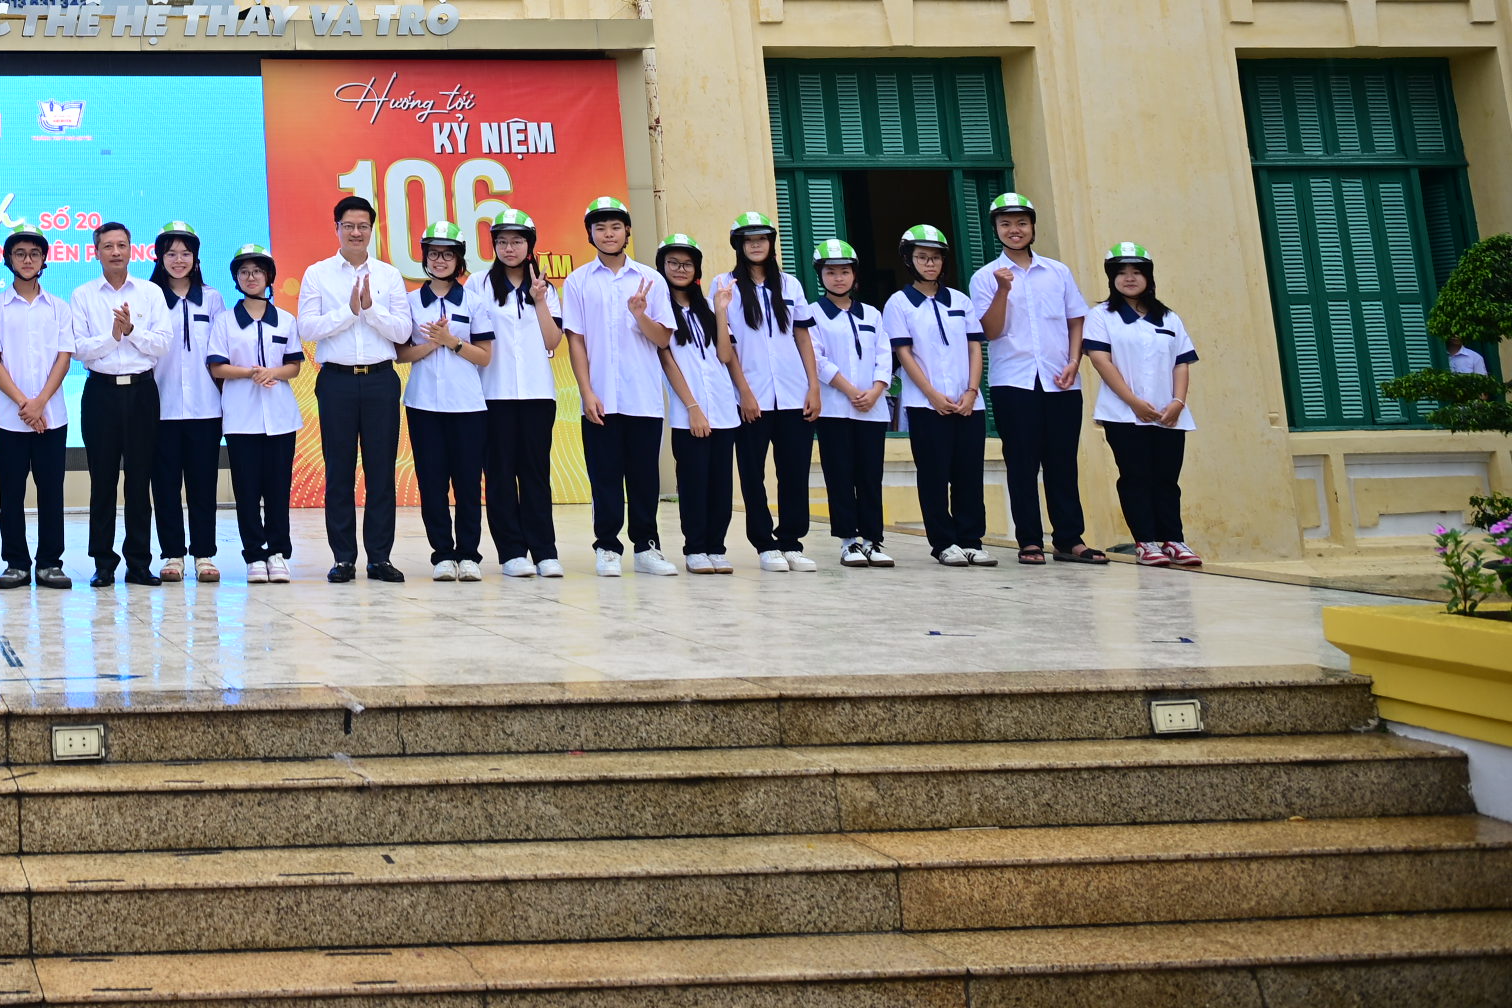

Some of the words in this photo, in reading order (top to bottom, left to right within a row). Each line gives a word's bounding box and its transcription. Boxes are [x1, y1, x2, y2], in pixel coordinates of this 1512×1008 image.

[334, 71, 438, 124] Hướng
[440, 84, 476, 111] tới
[432, 114, 468, 155] KỶ
[480, 118, 555, 160] NIỆM
[40, 206, 70, 230] SỐ
[76, 211, 103, 230] 20
[336, 157, 514, 282] 106
[46, 240, 79, 261] IÊN
[536, 249, 573, 280] ĂM
